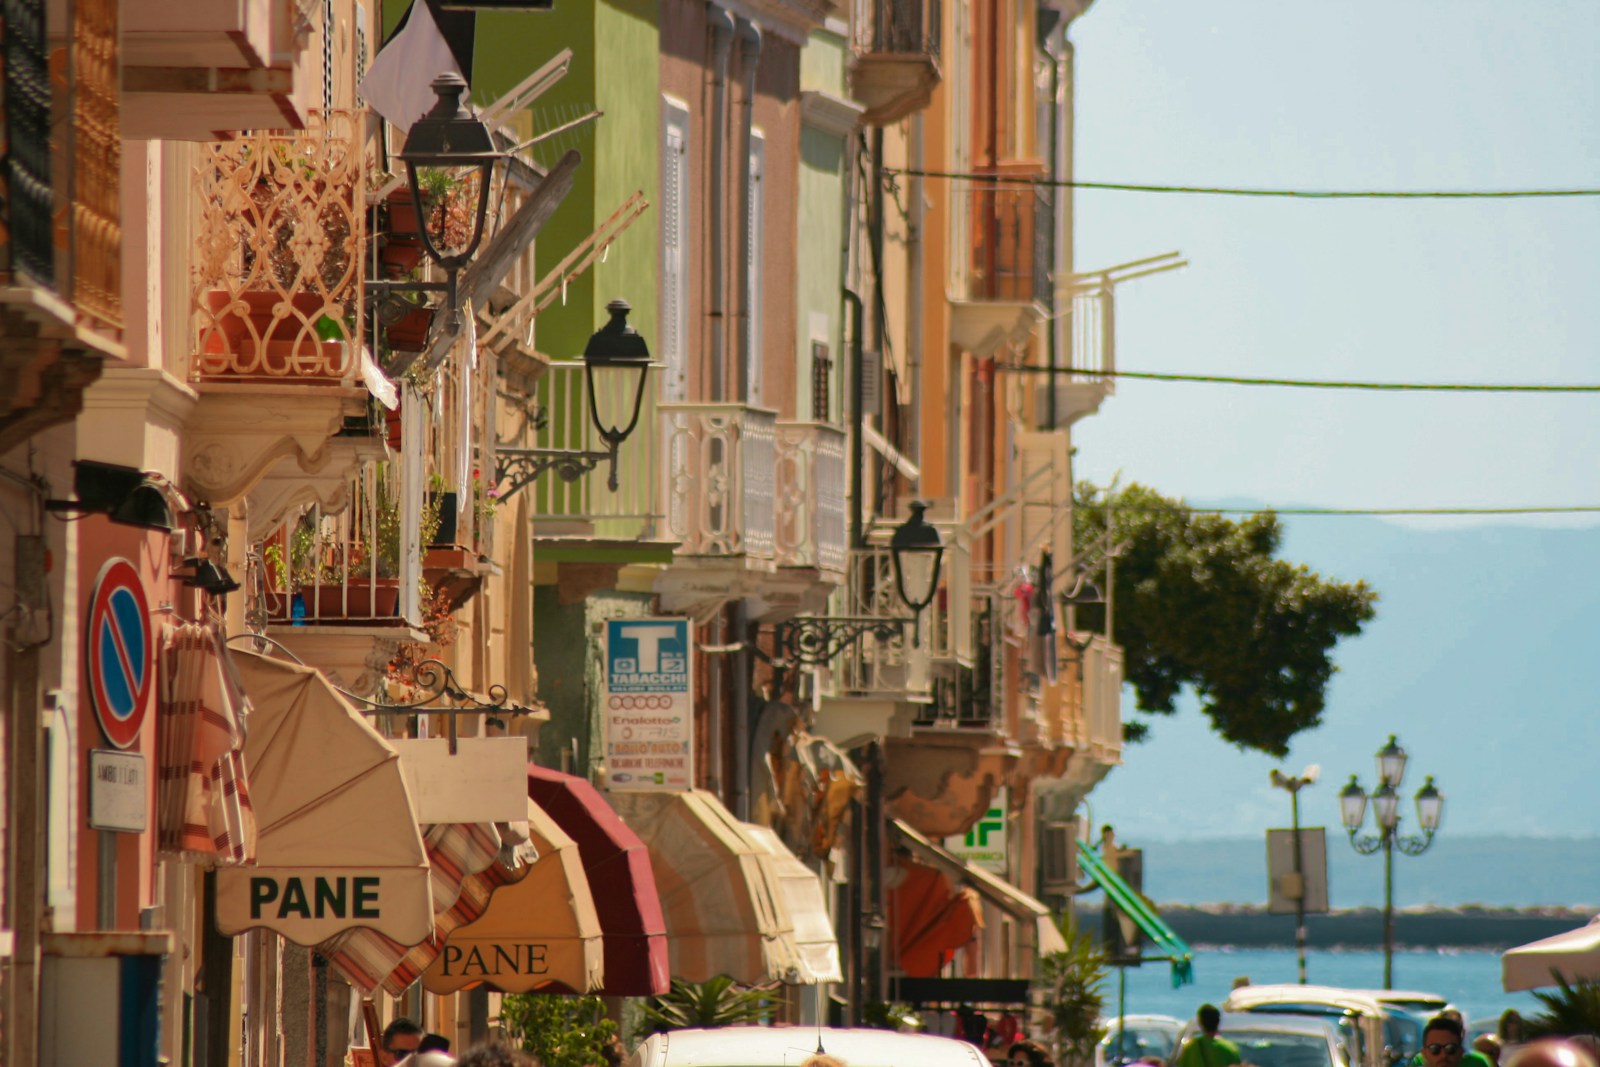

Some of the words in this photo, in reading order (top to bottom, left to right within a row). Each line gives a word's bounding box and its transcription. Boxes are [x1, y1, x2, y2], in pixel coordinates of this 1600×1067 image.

[611, 673, 687, 684] TABACCHI
[612, 716, 673, 725] Enalotto
[250, 876, 380, 919] PANE
[440, 944, 549, 977] PANE
